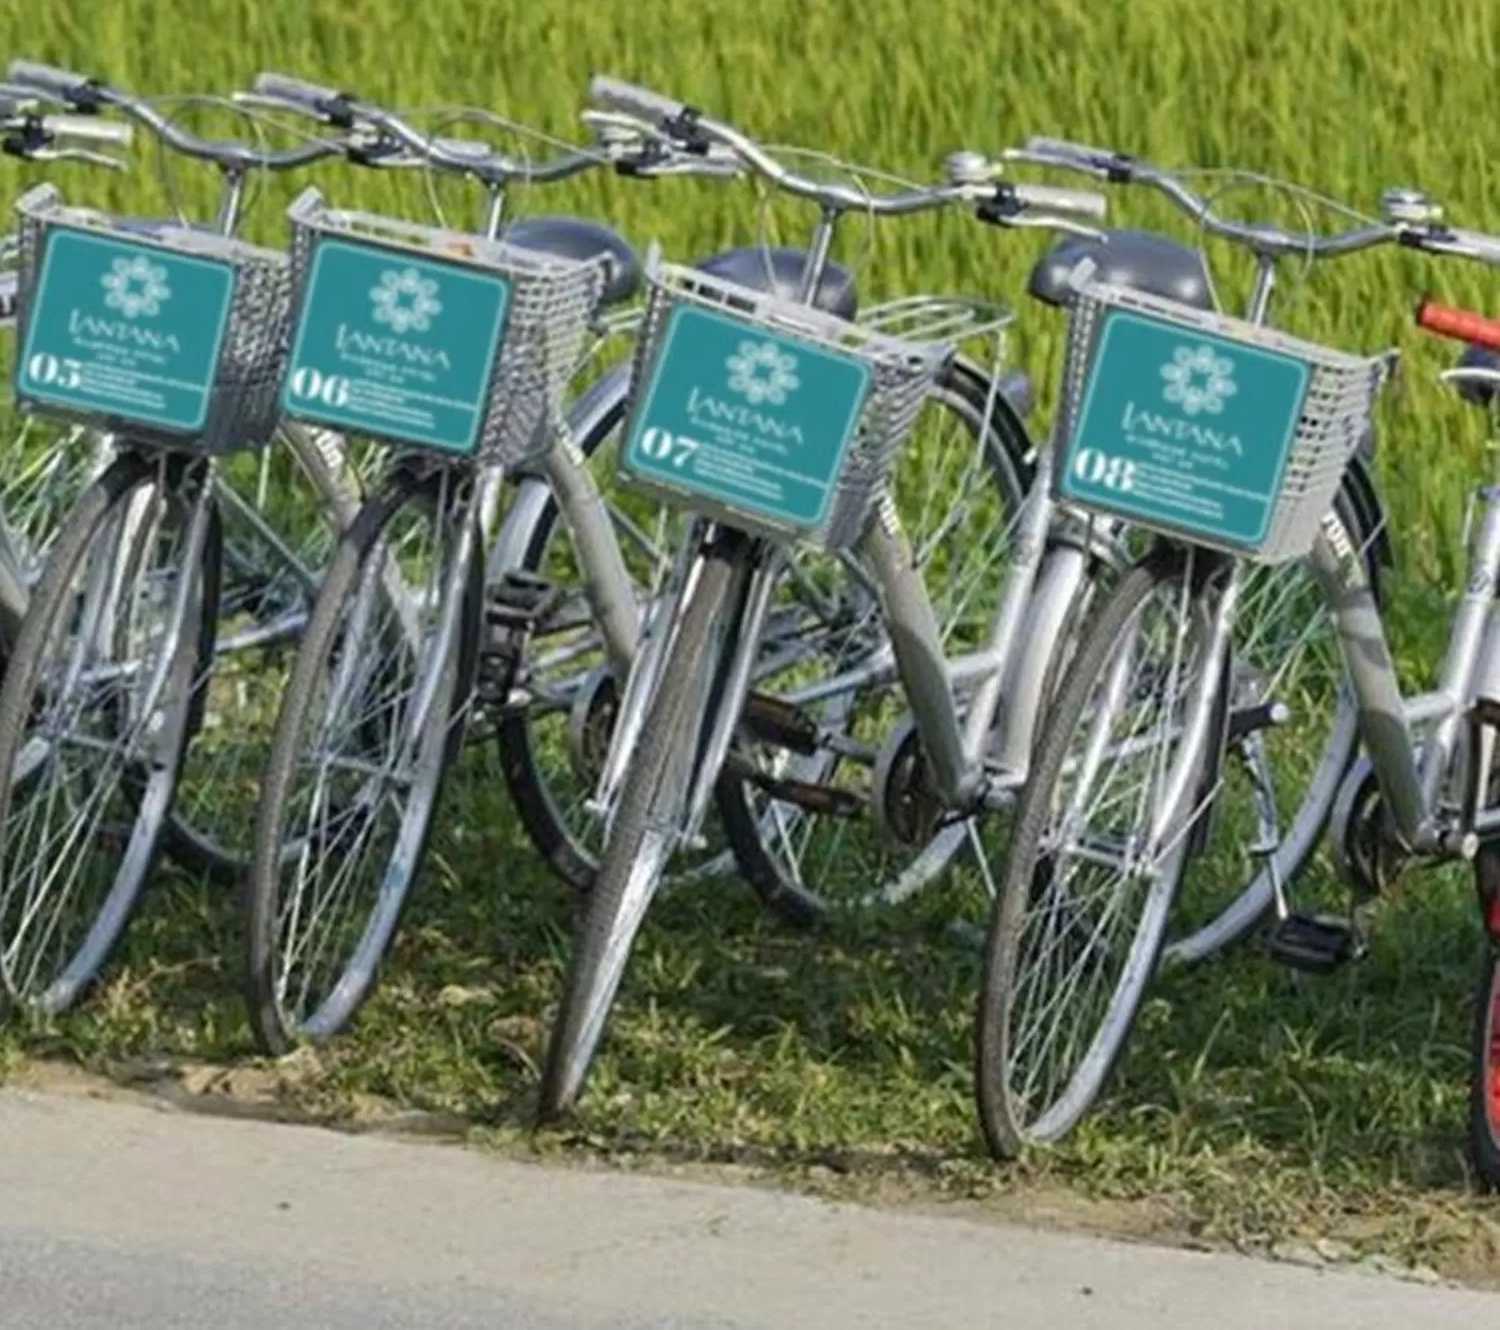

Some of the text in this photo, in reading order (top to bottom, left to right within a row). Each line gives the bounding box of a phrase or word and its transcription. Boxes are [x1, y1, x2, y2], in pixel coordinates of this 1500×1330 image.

[68, 307, 180, 354] LANTANA
[335, 322, 451, 369] LANTANA
[29, 352, 82, 388] 05
[290, 366, 349, 407] 06
[686, 386, 804, 447] LANTANA
[1122, 400, 1244, 460] LANTANA
[641, 427, 699, 467] 07
[1075, 446, 1136, 492] 08
